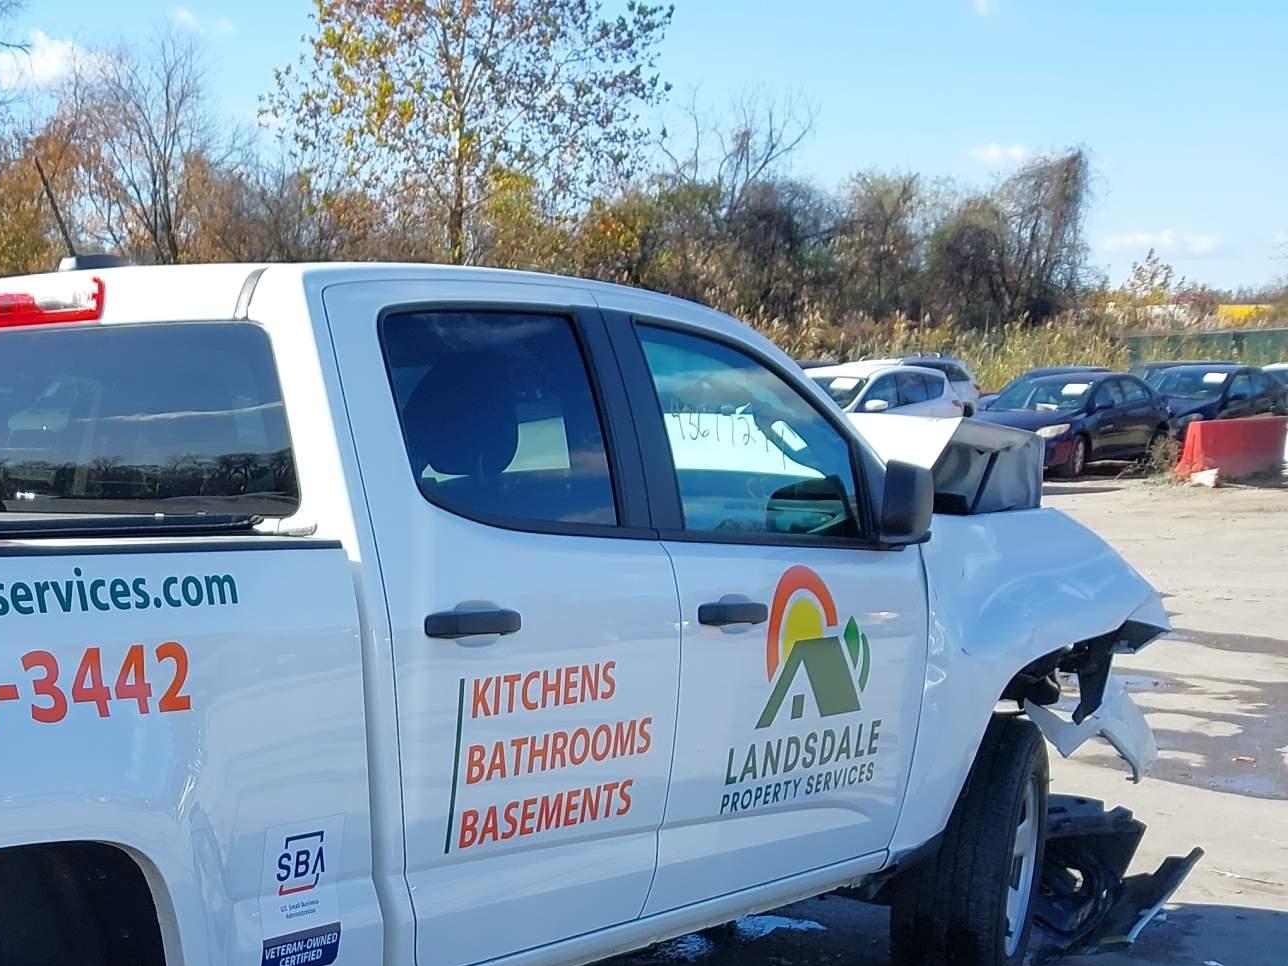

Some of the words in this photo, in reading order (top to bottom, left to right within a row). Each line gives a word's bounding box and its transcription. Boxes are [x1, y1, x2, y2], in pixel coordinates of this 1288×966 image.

[471, 661, 616, 718] KITCHENS
[466, 717, 653, 784] BATHROOMS
[724, 720, 882, 786] LANDSDALE
[458, 779, 634, 849] BASEMENTS
[720, 777, 802, 814] PROPERTY
[805, 762, 875, 796] SERVICES
[276, 846, 324, 882] SBA
[265, 932, 337, 960] VETERAN-OWNED
